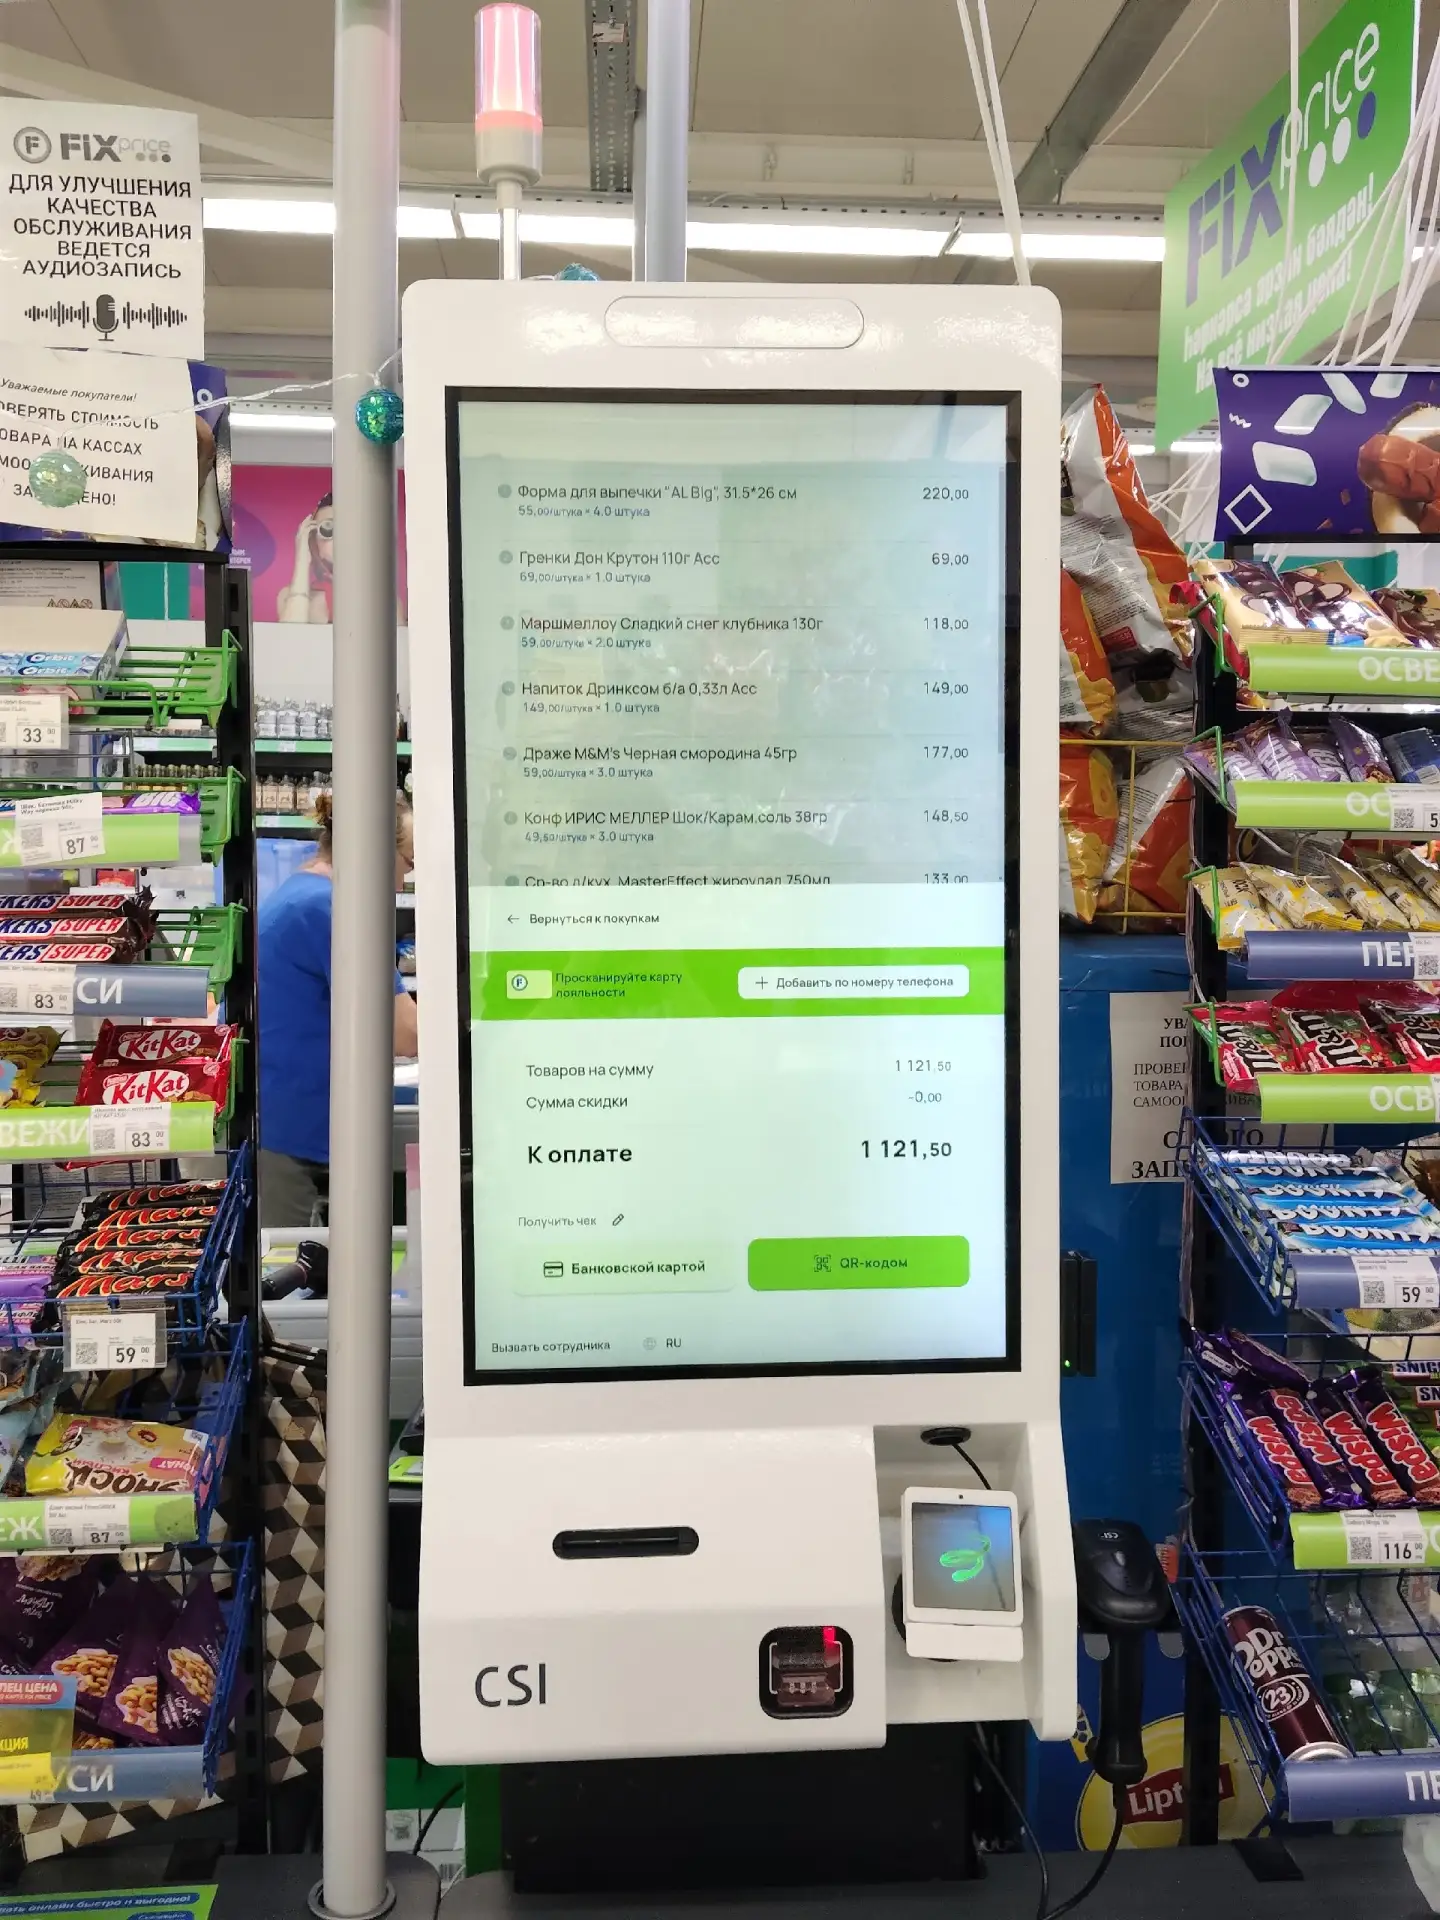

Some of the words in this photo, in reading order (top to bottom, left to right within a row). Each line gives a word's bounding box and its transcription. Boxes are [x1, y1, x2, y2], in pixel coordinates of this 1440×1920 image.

[9, 174, 53, 195] ДЛЯ
[58, 175, 192, 198] УЛУЧШЕНИЯ
[47, 197, 158, 218] КАЧЕСТВА
[14, 218, 192, 240] ОБСЛУЖИВАНИЯ
[58, 240, 151, 259] ВЕДЕТСЯ
[22, 260, 182, 280] АУДИОЗАПИСЬ
[0, 378, 69, 397] Уважаемые
[70, 389, 138, 403] покупатели!
[83, 438, 142, 456] КАССАХ
[517, 485, 568, 501] Форма
[569, 486, 597, 500] для
[599, 485, 662, 499] выпечки
[778, 489, 798, 499] см
[922, 487, 970, 500] 220,00
[613, 507, 651, 519] штука
[519, 551, 572, 566] Гренки
[573, 551, 604, 567] Дон
[606, 551, 660, 567] Крутон
[931, 552, 970, 567] 69,00
[615, 573, 652, 584] штука
[520, 617, 617, 631] Маршмеллоу
[619, 615, 684, 631] Сладкий
[686, 619, 720, 630] снег
[722, 616, 790, 631] клубника
[792, 617, 824, 630] 130г
[923, 617, 970, 631] 118,00
[615, 639, 652, 650] штука
[26, 652, 75, 663] Orbit
[18, 666, 69, 676] Orbit
[521, 682, 583, 696] Напиток
[586, 682, 660, 698] Дринксом
[662, 682, 687, 696] б/а
[688, 682, 729, 698] 0,33л
[923, 682, 970, 696] 149,00
[624, 703, 661, 714] штука
[22, 727, 42, 743] 33
[522, 748, 573, 763] Драже
[622, 747, 678, 763] Черная
[679, 750, 762, 763] смородина
[763, 747, 798, 763] 45гр
[923, 747, 970, 761] 177,00
[617, 768, 654, 780] штука
[524, 811, 563, 828] Конф
[564, 812, 607, 825] ИРИС
[609, 811, 670, 825] МЕЛЛЕР
[794, 811, 829, 827] 38гр
[923, 809, 970, 824] 148,50
[618, 832, 655, 844] штука
[65, 837, 85, 856] 87
[62, 895, 124, 908] SUPER
[60, 917, 124, 932] SUPER
[529, 913, 592, 926] Вернуться
[595, 915, 603, 925] к
[603, 914, 660, 926] покупкам
[49, 945, 116, 960] SUPER
[555, 971, 648, 985] Просканируйте
[649, 973, 683, 985] карту
[776, 977, 832, 990] Добавить
[834, 978, 850, 988] по
[851, 978, 895, 990] номеру
[896, 976, 955, 989] телефона
[75, 976, 124, 1005] СИ
[555, 987, 626, 998] лояльности
[34, 994, 55, 1010] 83
[126, 1030, 199, 1061] KitKat
[526, 1064, 586, 1080] Товаров
[588, 1065, 607, 1077] на
[608, 1065, 654, 1079] сумму
[112, 1071, 188, 1105] KitKat
[1133, 1080, 1184, 1092] ТОВАРА
[526, 1096, 576, 1112] Сумма
[577, 1096, 628, 1110] скидки
[131, 1132, 151, 1148] 83
[527, 1145, 544, 1165] К
[547, 1146, 634, 1164] оплате
[1131, 1160, 1190, 1179] ЗАП
[517, 1216, 575, 1230] Получить
[576, 1216, 598, 1227] чек
[75, 1228, 204, 1253] Mars
[571, 1261, 655, 1276] Банковской
[656, 1259, 706, 1276] картой
[839, 1256, 909, 1270] QR-кодом
[56, 1272, 193, 1299] Mars
[1402, 1286, 1421, 1303] 59
[491, 1341, 541, 1354] Вызвать
[541, 1340, 611, 1354] сотрудника
[665, 1337, 683, 1349] RU
[115, 1346, 137, 1364] 59
[1274, 1393, 1344, 1466] Wispa
[1247, 1415, 1315, 1485] Wispa
[1322, 1411, 1398, 1486] Wispa
[1365, 1400, 1440, 1485] Wispa
[90, 1532, 110, 1544] 87
[1384, 1542, 1412, 1560] 116
[1245, 1627, 1285, 1656] Dr
[25, 1681, 58, 1694] ЦЕНА
[474, 1663, 548, 1708] CSI
[1264, 1686, 1292, 1710] 23
[28, 1902, 74, 1912] онлайн
[76, 1899, 122, 1909] быстро
